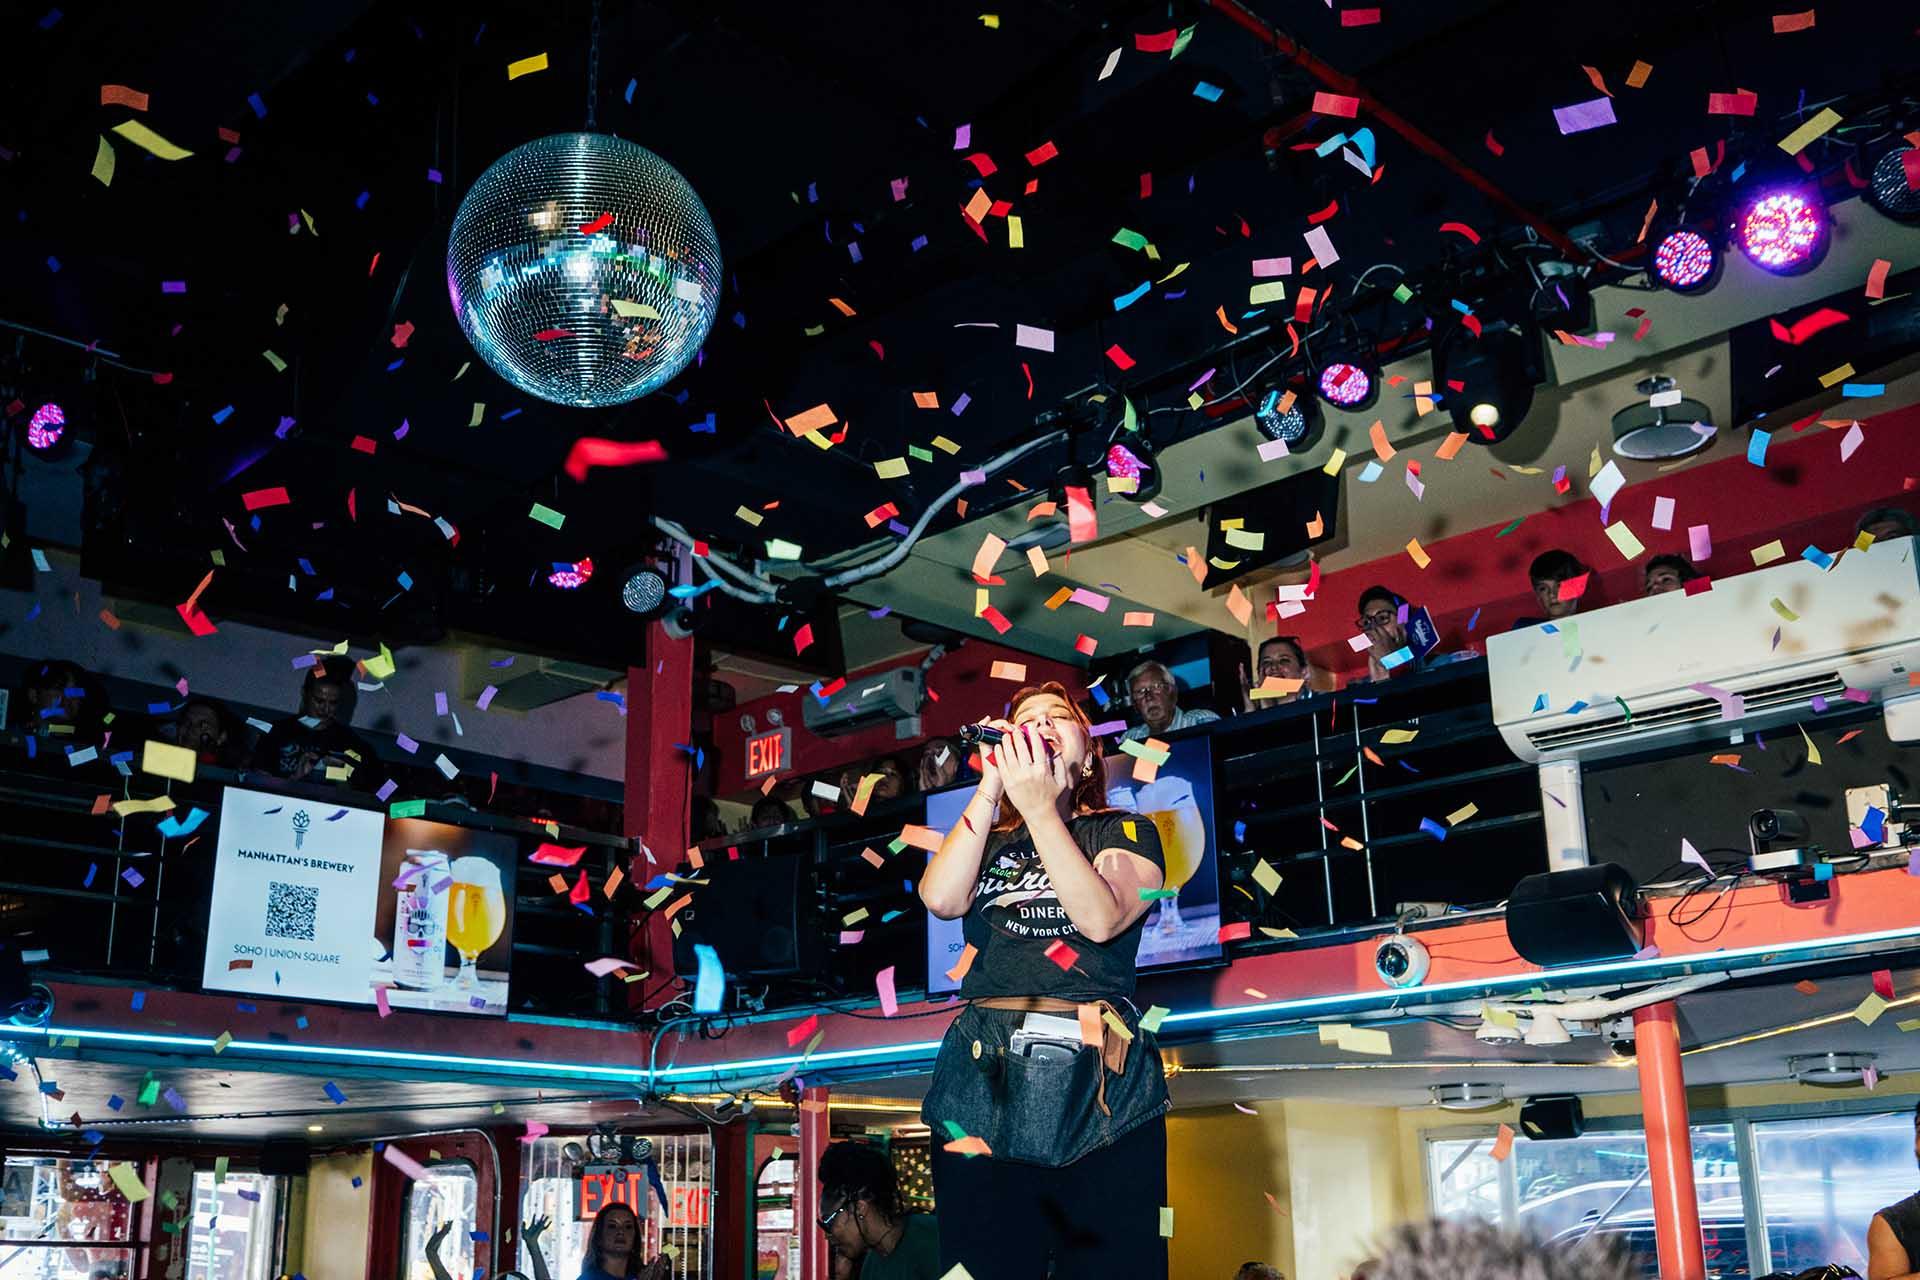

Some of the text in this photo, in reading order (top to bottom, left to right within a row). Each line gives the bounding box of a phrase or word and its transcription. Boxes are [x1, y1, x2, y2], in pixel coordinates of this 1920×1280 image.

[749, 733, 783, 776] EXIT
[237, 849, 355, 873] MANHATTAN'S BREWERY
[989, 866, 1013, 879] nicole
[1020, 906, 1066, 919] DINER
[1005, 919, 1079, 937] NEW YORK CIT
[233, 944, 341, 964] SOHO UNION SQUARE
[580, 1172, 642, 1219] EXIT
